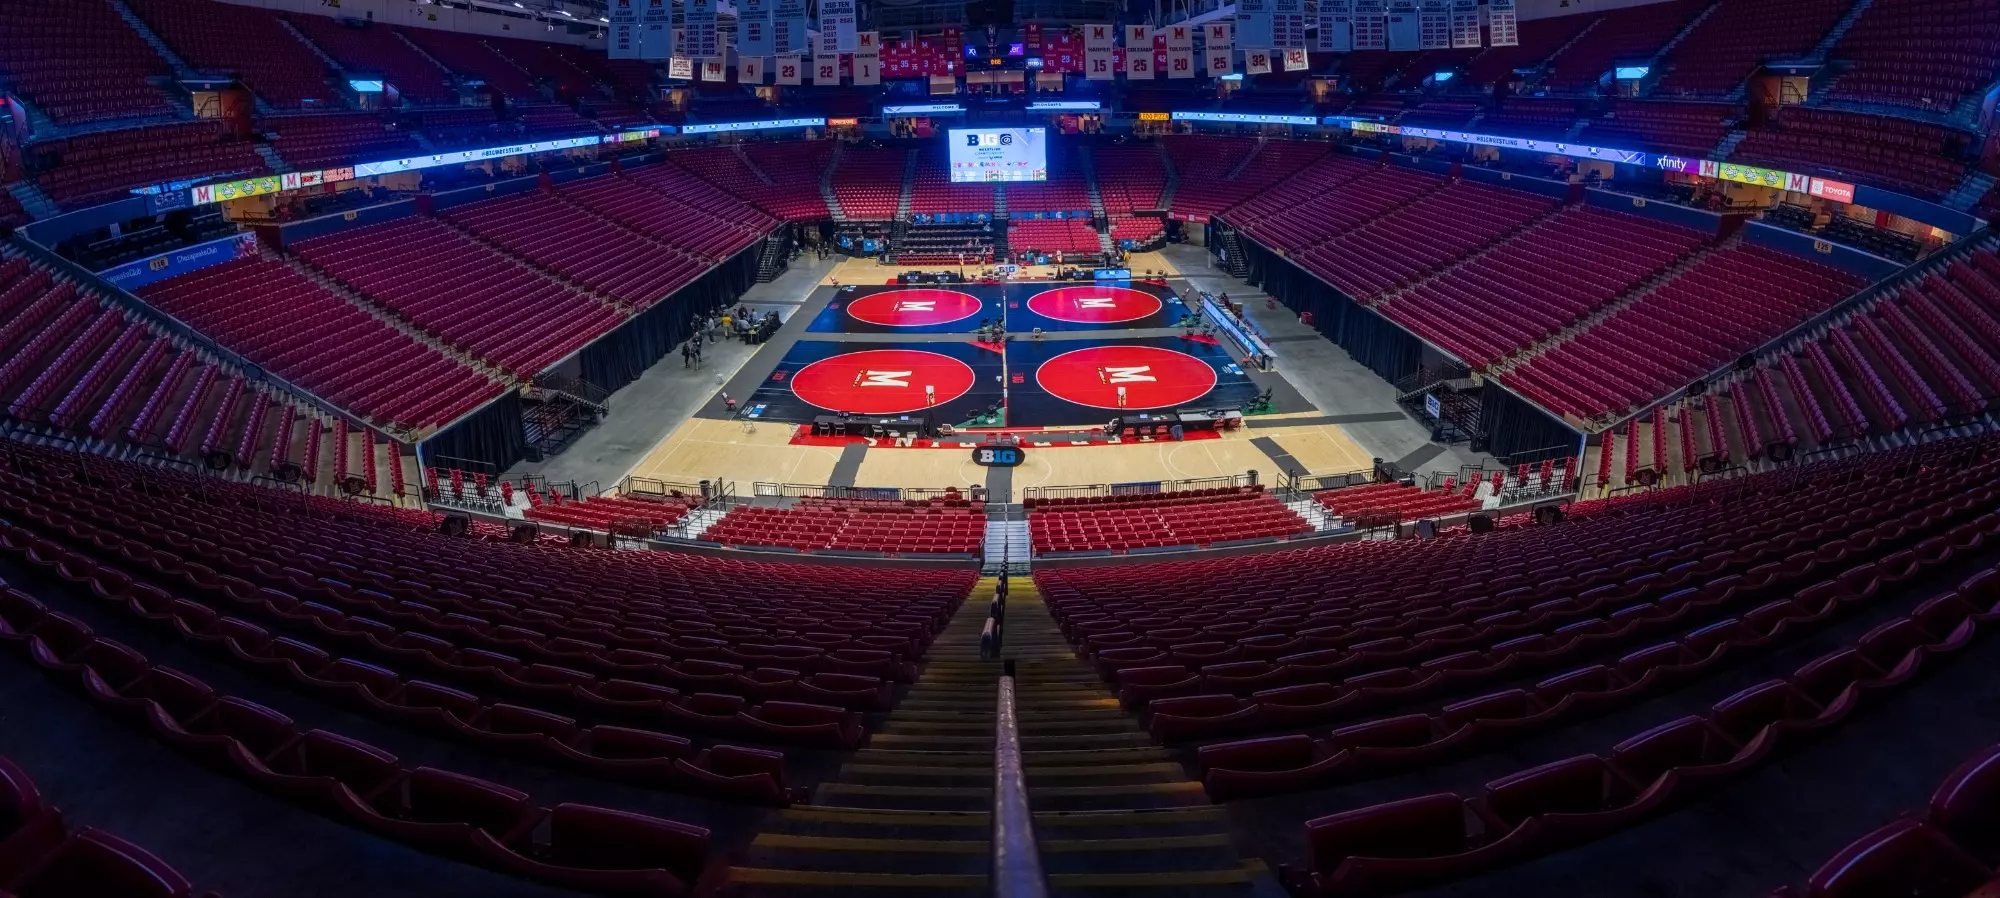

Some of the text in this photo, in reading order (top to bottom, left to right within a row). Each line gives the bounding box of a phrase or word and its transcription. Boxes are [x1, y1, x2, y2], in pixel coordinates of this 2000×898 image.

[1093, 27, 1104, 39] M
[1134, 27, 1144, 39] M
[1174, 27, 1184, 39] M
[1213, 26, 1223, 38] M
[861, 34, 871, 46] M
[1061, 55, 1070, 63] 23
[1213, 57, 1226, 69] 25
[1252, 54, 1265, 66] 32
[1289, 52, 1301, 63] 42
[708, 63, 720, 74] 44
[747, 64, 754, 76] 4
[900, 60, 909, 68] 35
[1093, 60, 1106, 72] 15
[1133, 60, 1147, 72] 25
[1174, 58, 1187, 70] 20
[782, 66, 795, 77] 23
[820, 66, 833, 78] 22
[864, 65, 870, 77] 1
[1657, 155, 1687, 172] xfinity
[1704, 160, 1714, 175] M
[286, 174, 297, 188] M
[1790, 173, 1804, 188] M
[196, 186, 210, 203] M
[1824, 186, 1851, 198] TOYOTA
[1817, 242, 1829, 250] 125
[153, 259, 165, 268] 116
[898, 301, 936, 311] M
[1079, 297, 1116, 308] M
[860, 370, 913, 388] M
[1104, 365, 1157, 384] M
